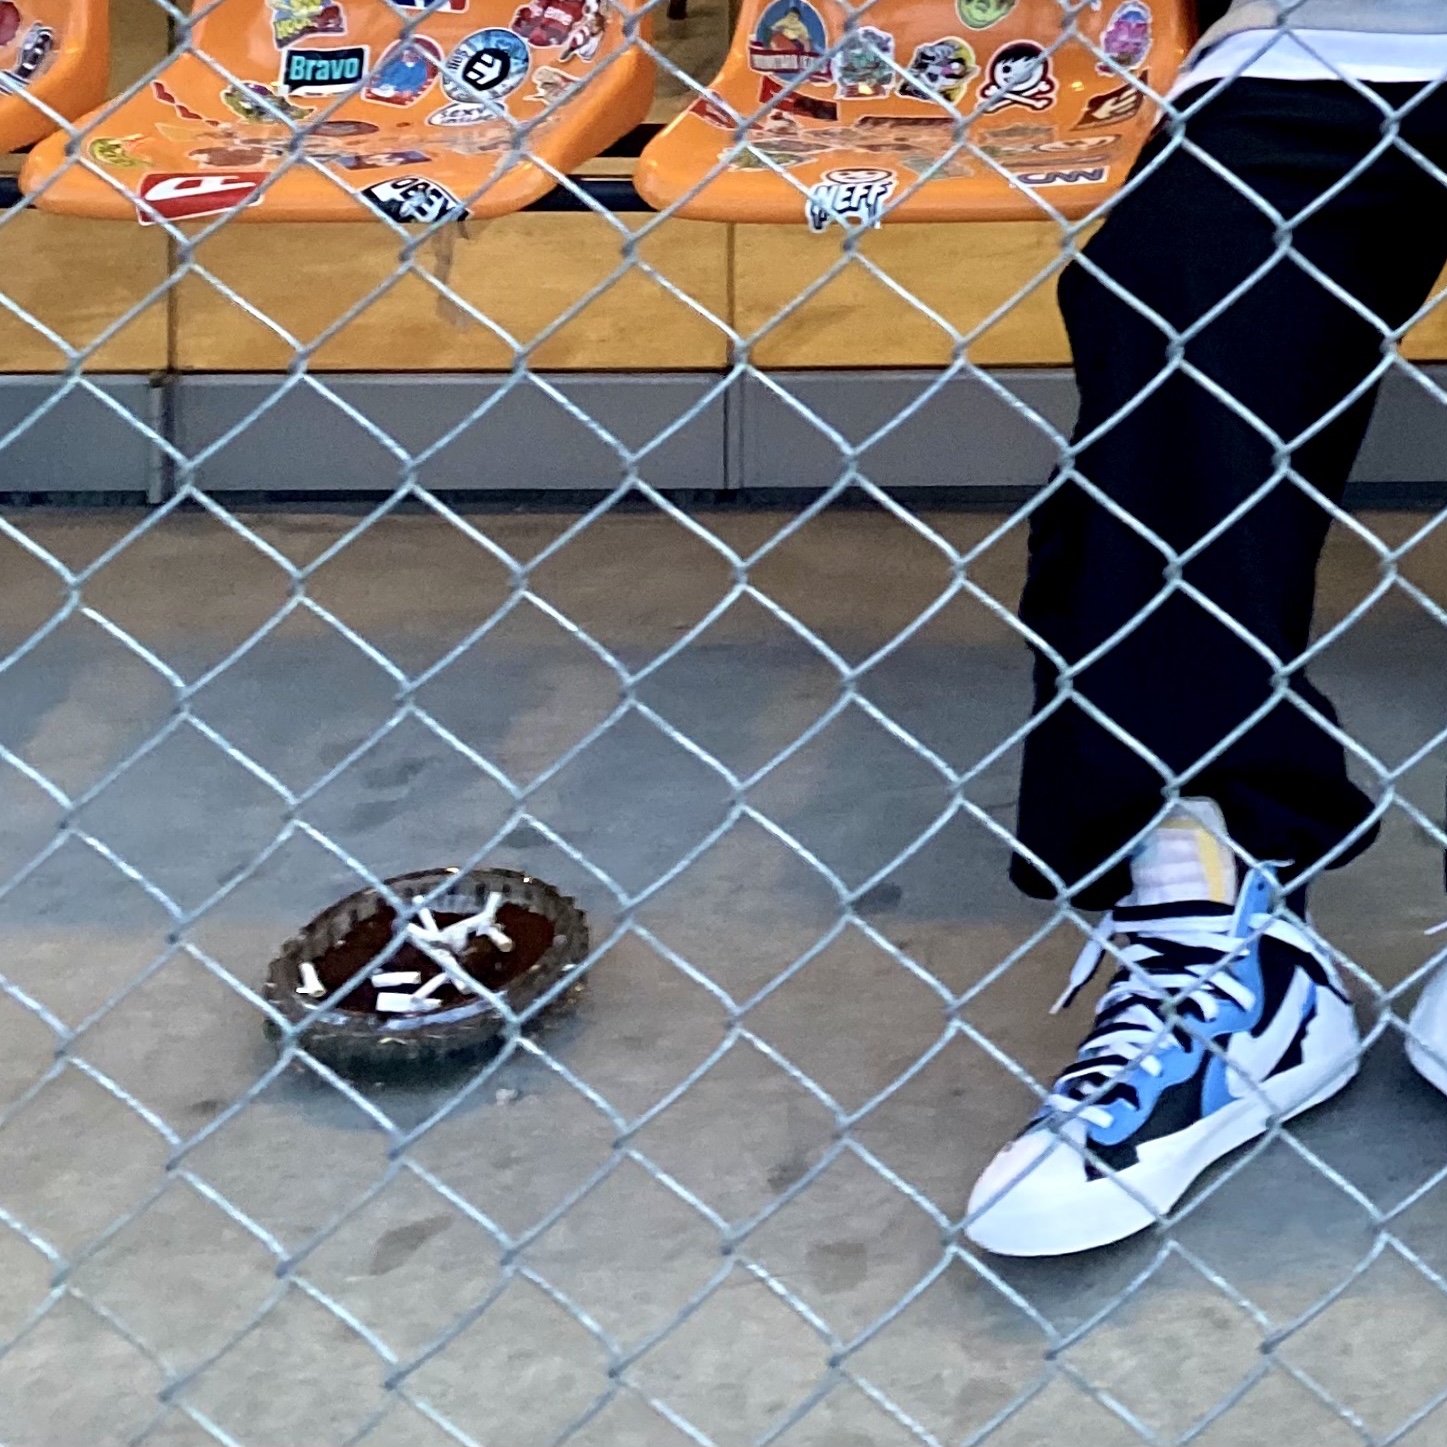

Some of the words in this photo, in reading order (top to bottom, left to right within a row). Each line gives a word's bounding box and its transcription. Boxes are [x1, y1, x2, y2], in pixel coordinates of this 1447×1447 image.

[289, 55, 360, 81] Bravo
[1017, 168, 1105, 184] CNN
[811, 181, 893, 222] NEFF
